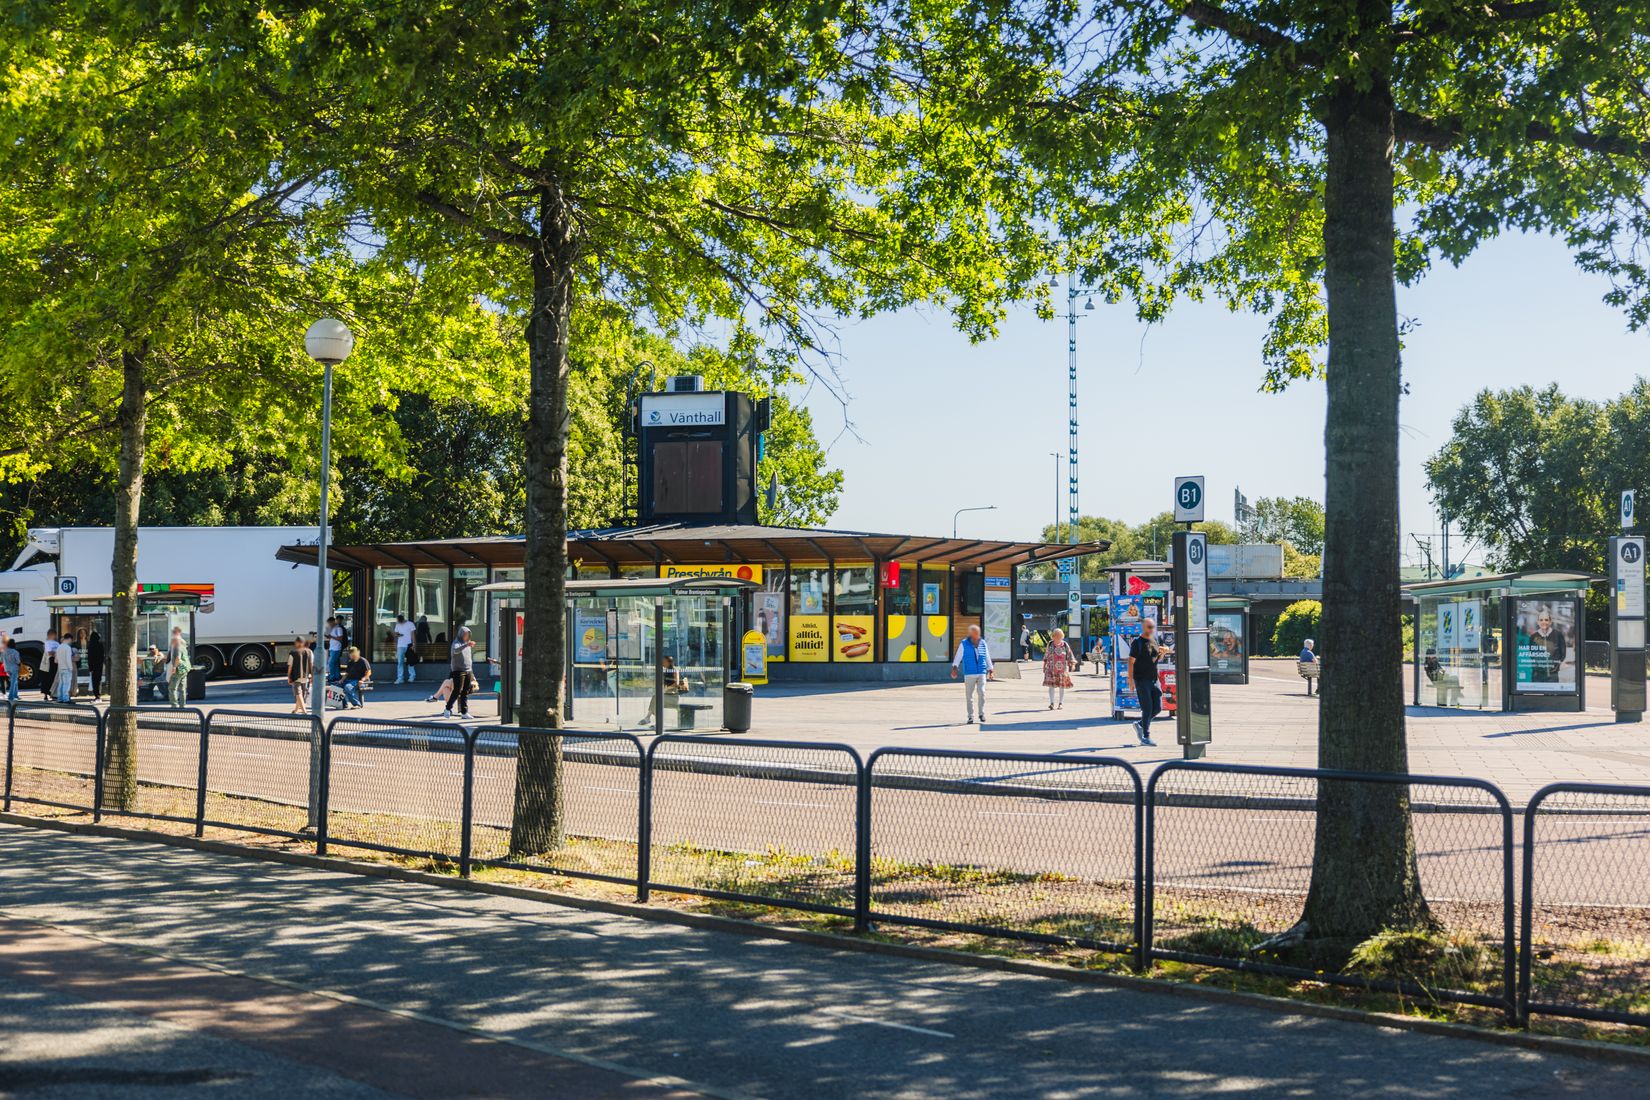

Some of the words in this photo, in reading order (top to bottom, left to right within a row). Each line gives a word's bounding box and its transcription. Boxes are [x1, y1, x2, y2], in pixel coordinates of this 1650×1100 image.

[670, 410, 721, 423] Vänthall
[1181, 488, 1197, 503] B1
[1623, 501, 1631, 512] A1
[1191, 545, 1201, 559] B1
[1623, 547, 1637, 559] A1
[667, 567, 732, 578] Pressbyrån
[63, 582, 72, 590] B1
[794, 640, 824, 650] alltid!
